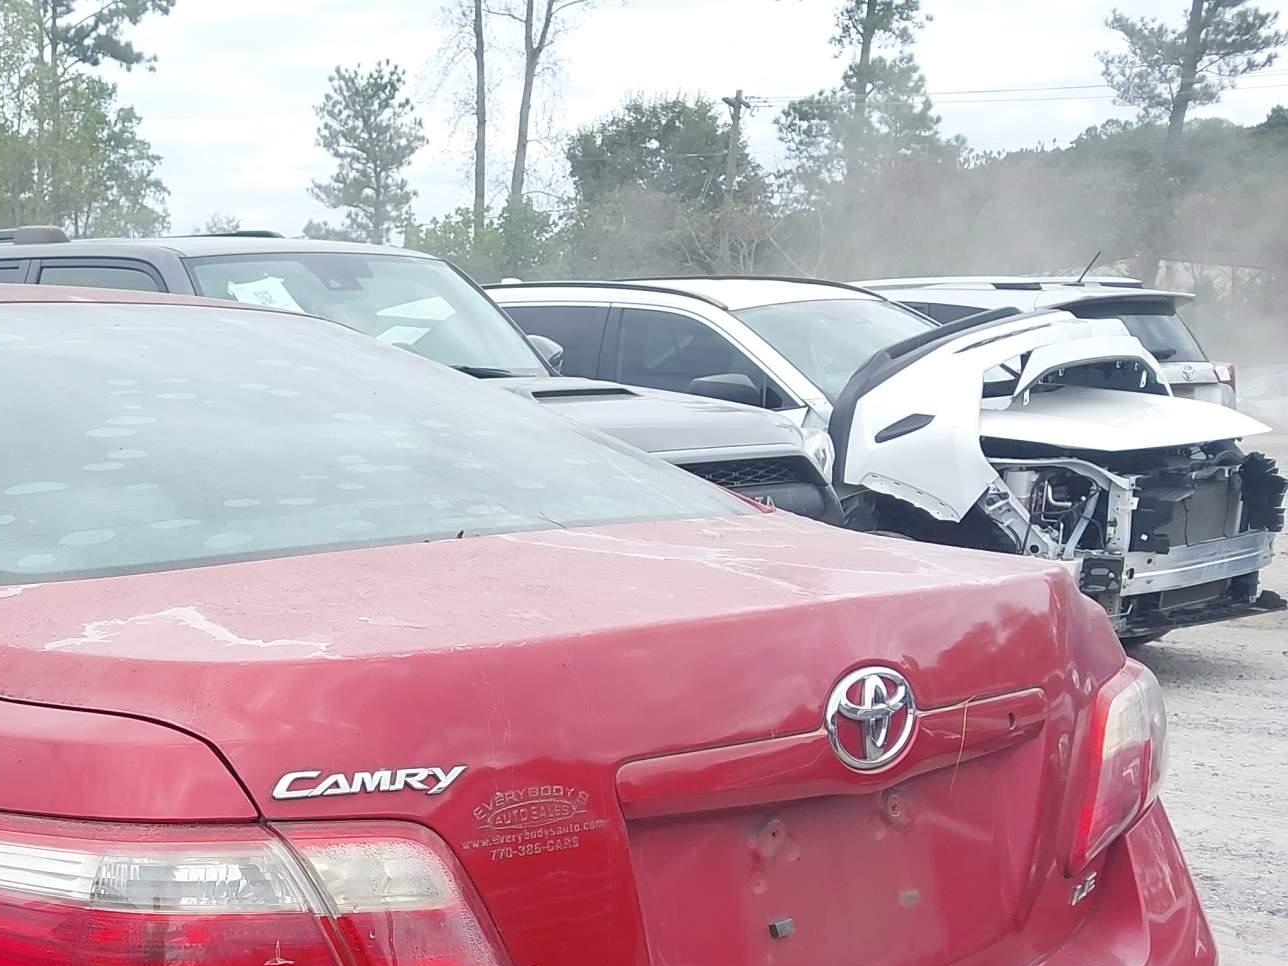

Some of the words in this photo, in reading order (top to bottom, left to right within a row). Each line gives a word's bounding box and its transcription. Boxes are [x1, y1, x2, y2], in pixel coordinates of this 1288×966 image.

[272, 765, 468, 800] CAMRY
[495, 808, 529, 825] AUTO
[531, 803, 569, 820] SALES
[1071, 871, 1097, 906] LE
